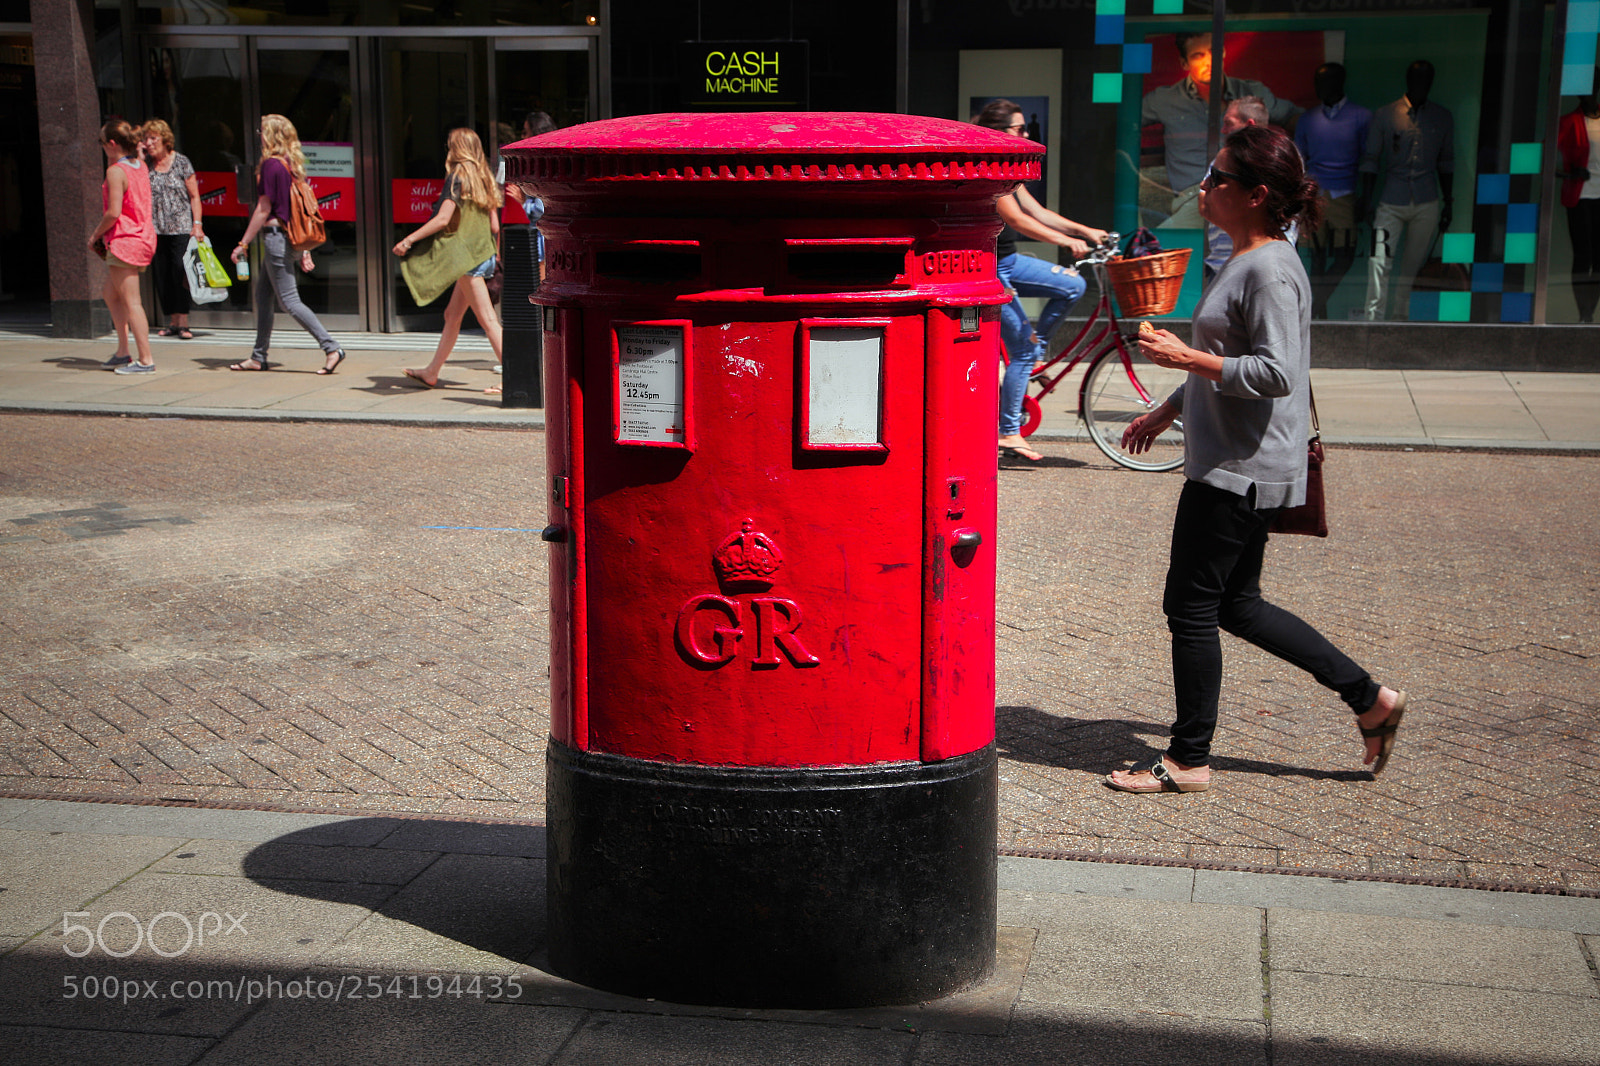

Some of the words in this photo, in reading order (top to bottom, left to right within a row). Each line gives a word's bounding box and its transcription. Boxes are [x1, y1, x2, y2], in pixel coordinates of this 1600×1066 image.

[705, 50, 780, 76] CASH
[705, 77, 780, 94] MACHINE
[305, 158, 352, 166] spencer.com
[411, 181, 437, 196] sale
[552, 250, 586, 273] POST
[623, 337, 645, 345] Monday
[652, 338, 671, 346] Friday
[626, 345, 654, 356] 6.30pm
[623, 380, 648, 390] Saturday
[627, 388, 660, 400] 12.45pm
[673, 592, 821, 671] GR
